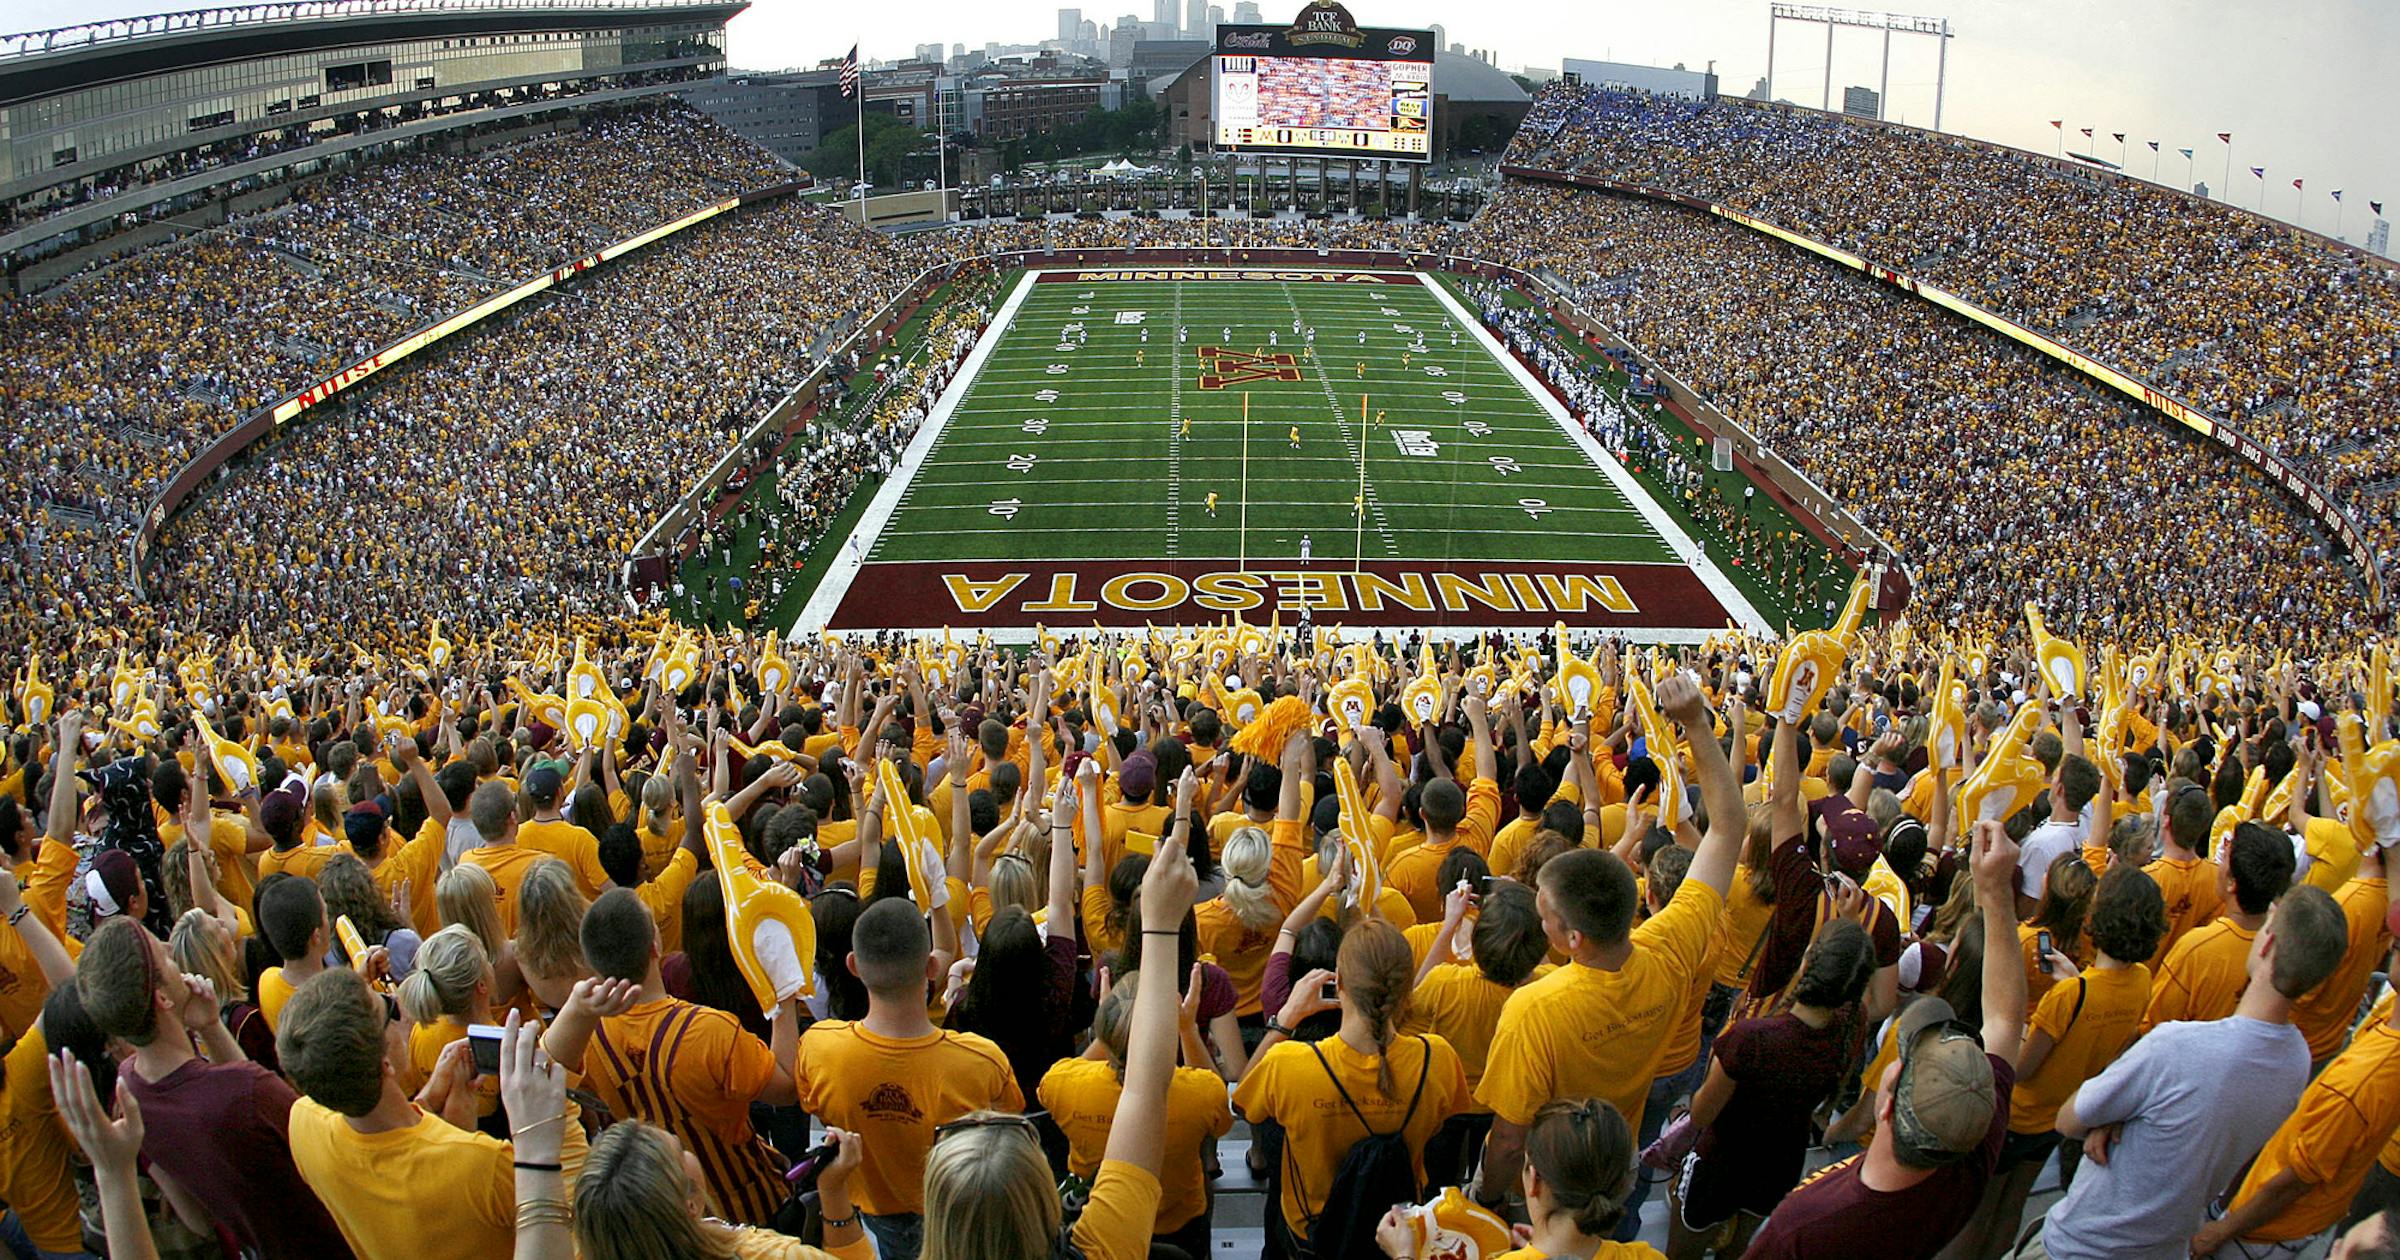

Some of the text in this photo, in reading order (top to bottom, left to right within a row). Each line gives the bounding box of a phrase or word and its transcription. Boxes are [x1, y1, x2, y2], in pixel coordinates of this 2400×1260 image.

[1312, 11, 1338, 21] TCF
[1308, 21, 1342, 32] BANK
[1393, 40, 1412, 50] DQ
[1392, 63, 1428, 71] GOPHER
[1077, 271, 1387, 283] MINNESOTA
[1022, 418, 1050, 432] 30
[1463, 421, 1494, 436] 30
[2216, 426, 2237, 448] 1900
[2240, 440, 2262, 464] 1903
[2264, 457, 2284, 481] 1904
[1006, 453, 1038, 470] 20
[1488, 456, 1523, 473] 20
[988, 497, 1022, 515] 10
[1518, 498, 1553, 515] 10
[940, 571, 1641, 614] MINNESOTA
[1583, 1030, 1604, 1042] Get
[1313, 1094, 1406, 1110] Get Bckstage.
